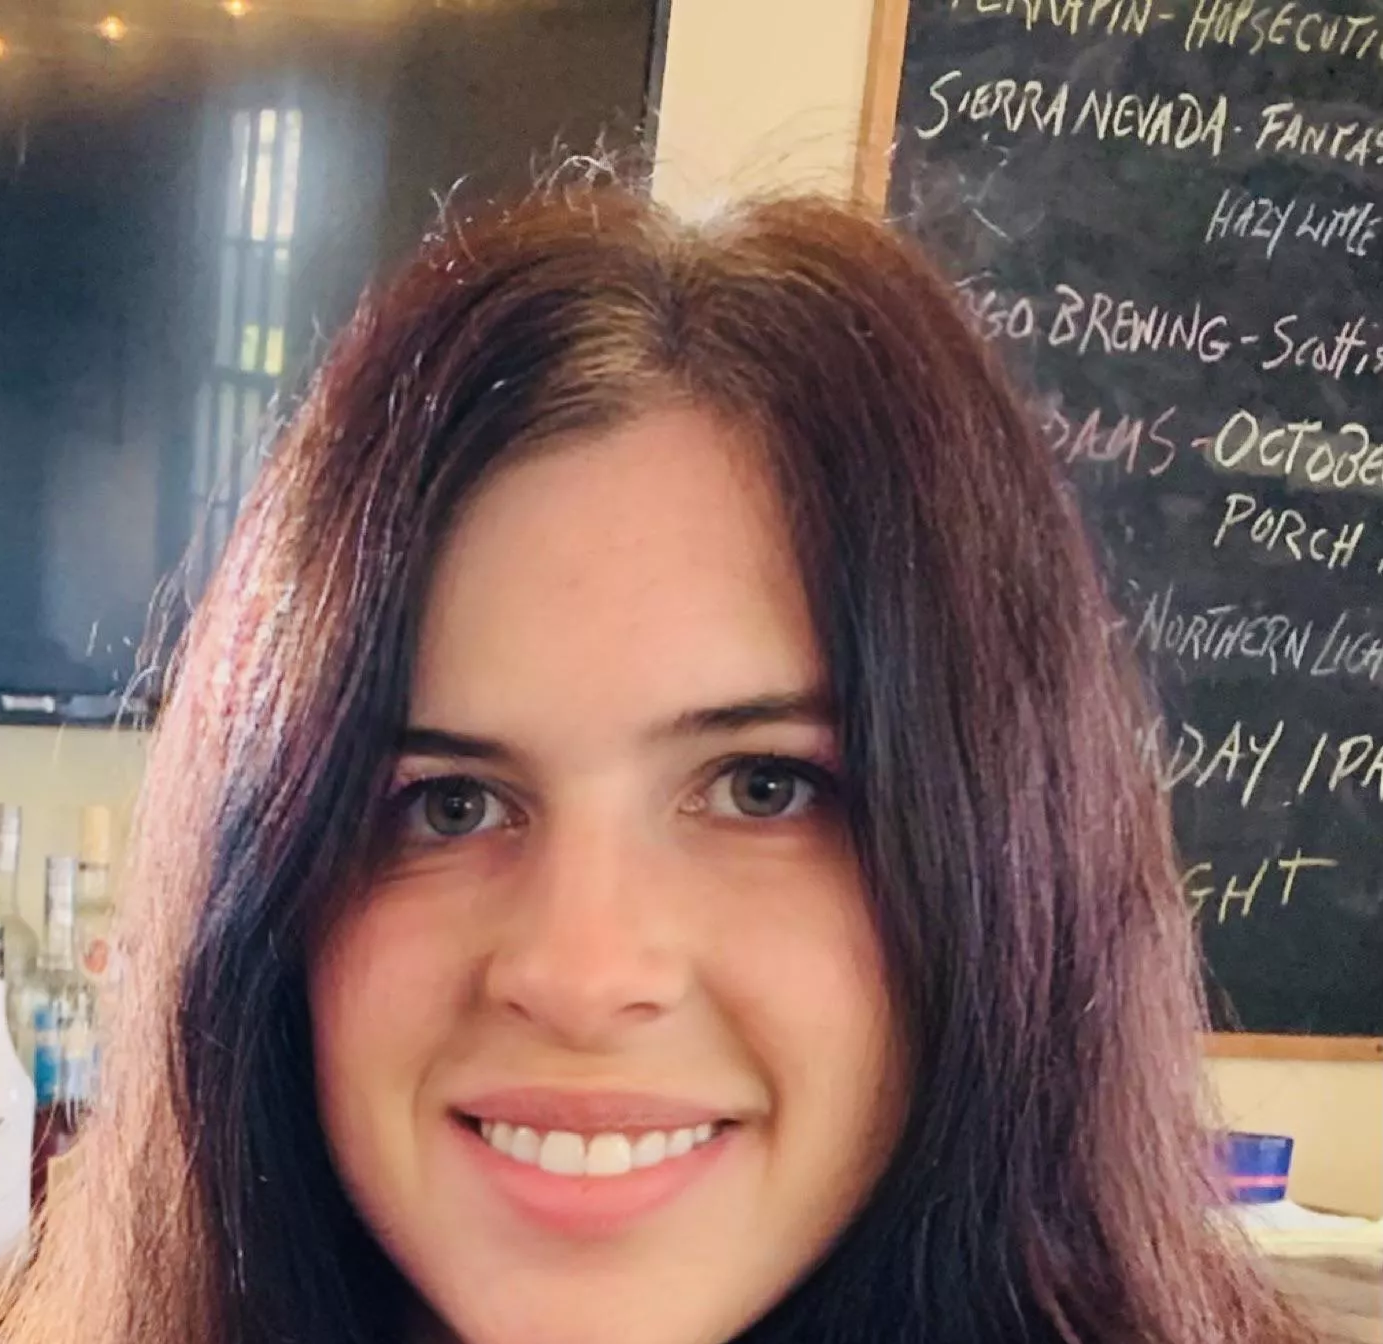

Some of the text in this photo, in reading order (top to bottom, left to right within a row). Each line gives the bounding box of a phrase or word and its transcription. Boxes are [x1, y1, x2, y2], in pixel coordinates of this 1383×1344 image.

[1184, 0, 1383, 59] HOPSECUTI
[917, 70, 1070, 138] SIERRA
[1205, 188, 1296, 259] HAZY
[1049, 283, 1231, 362] BREWING
[1213, 493, 1365, 570] PORCH
